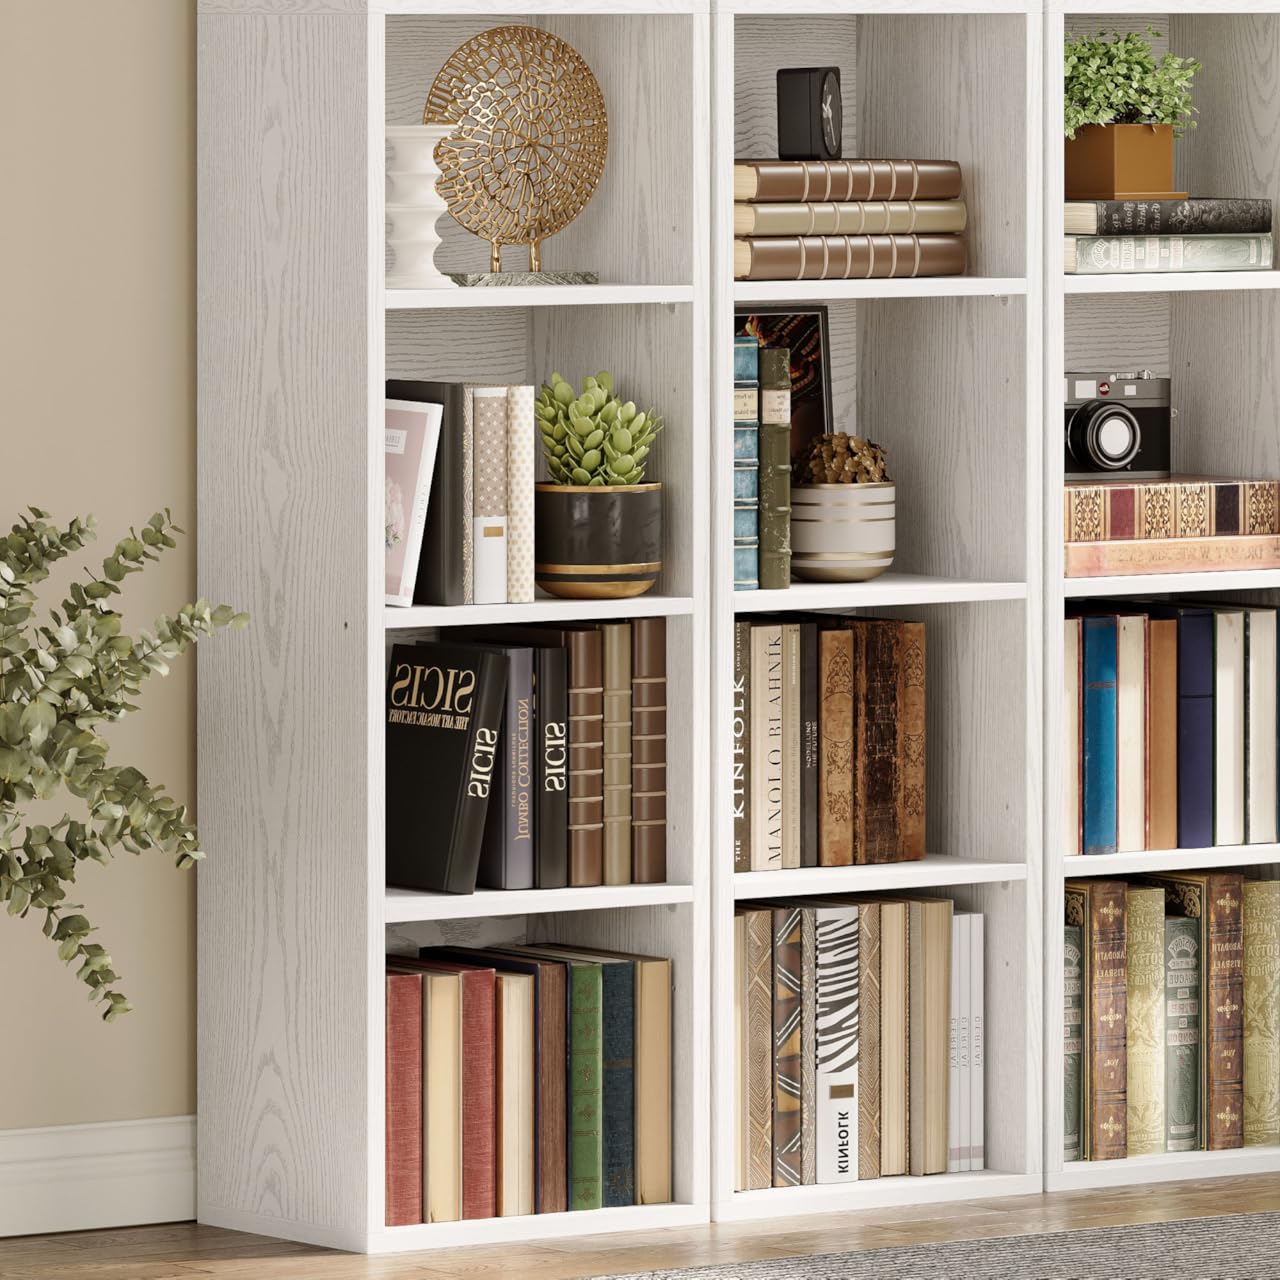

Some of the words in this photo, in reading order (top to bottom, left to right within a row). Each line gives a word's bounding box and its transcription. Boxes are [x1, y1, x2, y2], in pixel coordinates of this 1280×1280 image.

[764, 635, 781, 737] BLAHNÍK
[734, 675, 745, 819] KINFOLK
[768, 748, 781, 863] MANOLO
